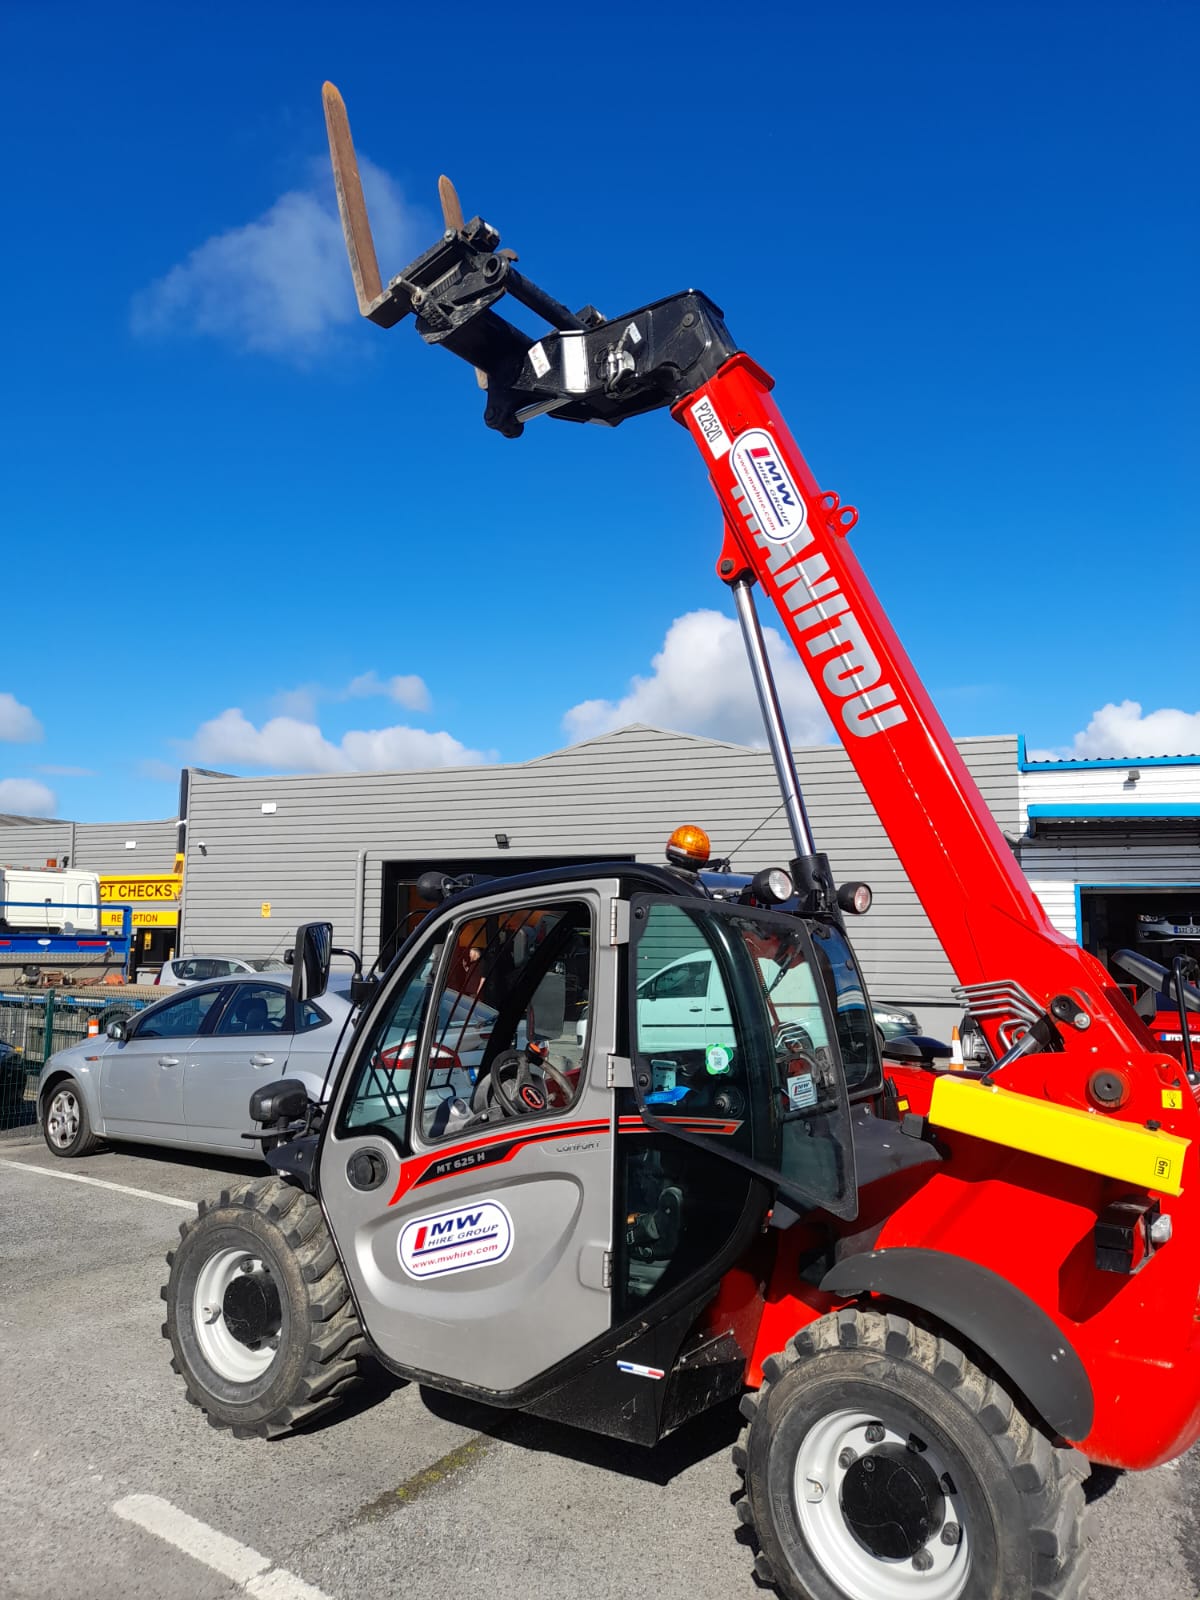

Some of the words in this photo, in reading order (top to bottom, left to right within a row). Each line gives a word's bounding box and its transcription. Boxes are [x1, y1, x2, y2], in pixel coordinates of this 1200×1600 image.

[695, 402, 723, 443] P22520
[737, 453, 776, 531] www.mwhire.com
[757, 462, 771, 486] HIRE
[770, 489, 791, 526] GROUP
[119, 884, 173, 898] CHECKS
[111, 913, 158, 923] REPTION
[436, 1161, 453, 1175] MT
[454, 1156, 475, 1169] 625
[477, 1152, 486, 1162] H
[427, 1234, 454, 1247] HIRE
[457, 1224, 499, 1239] GROUP
[411, 1243, 498, 1269] www.mwhire.com
